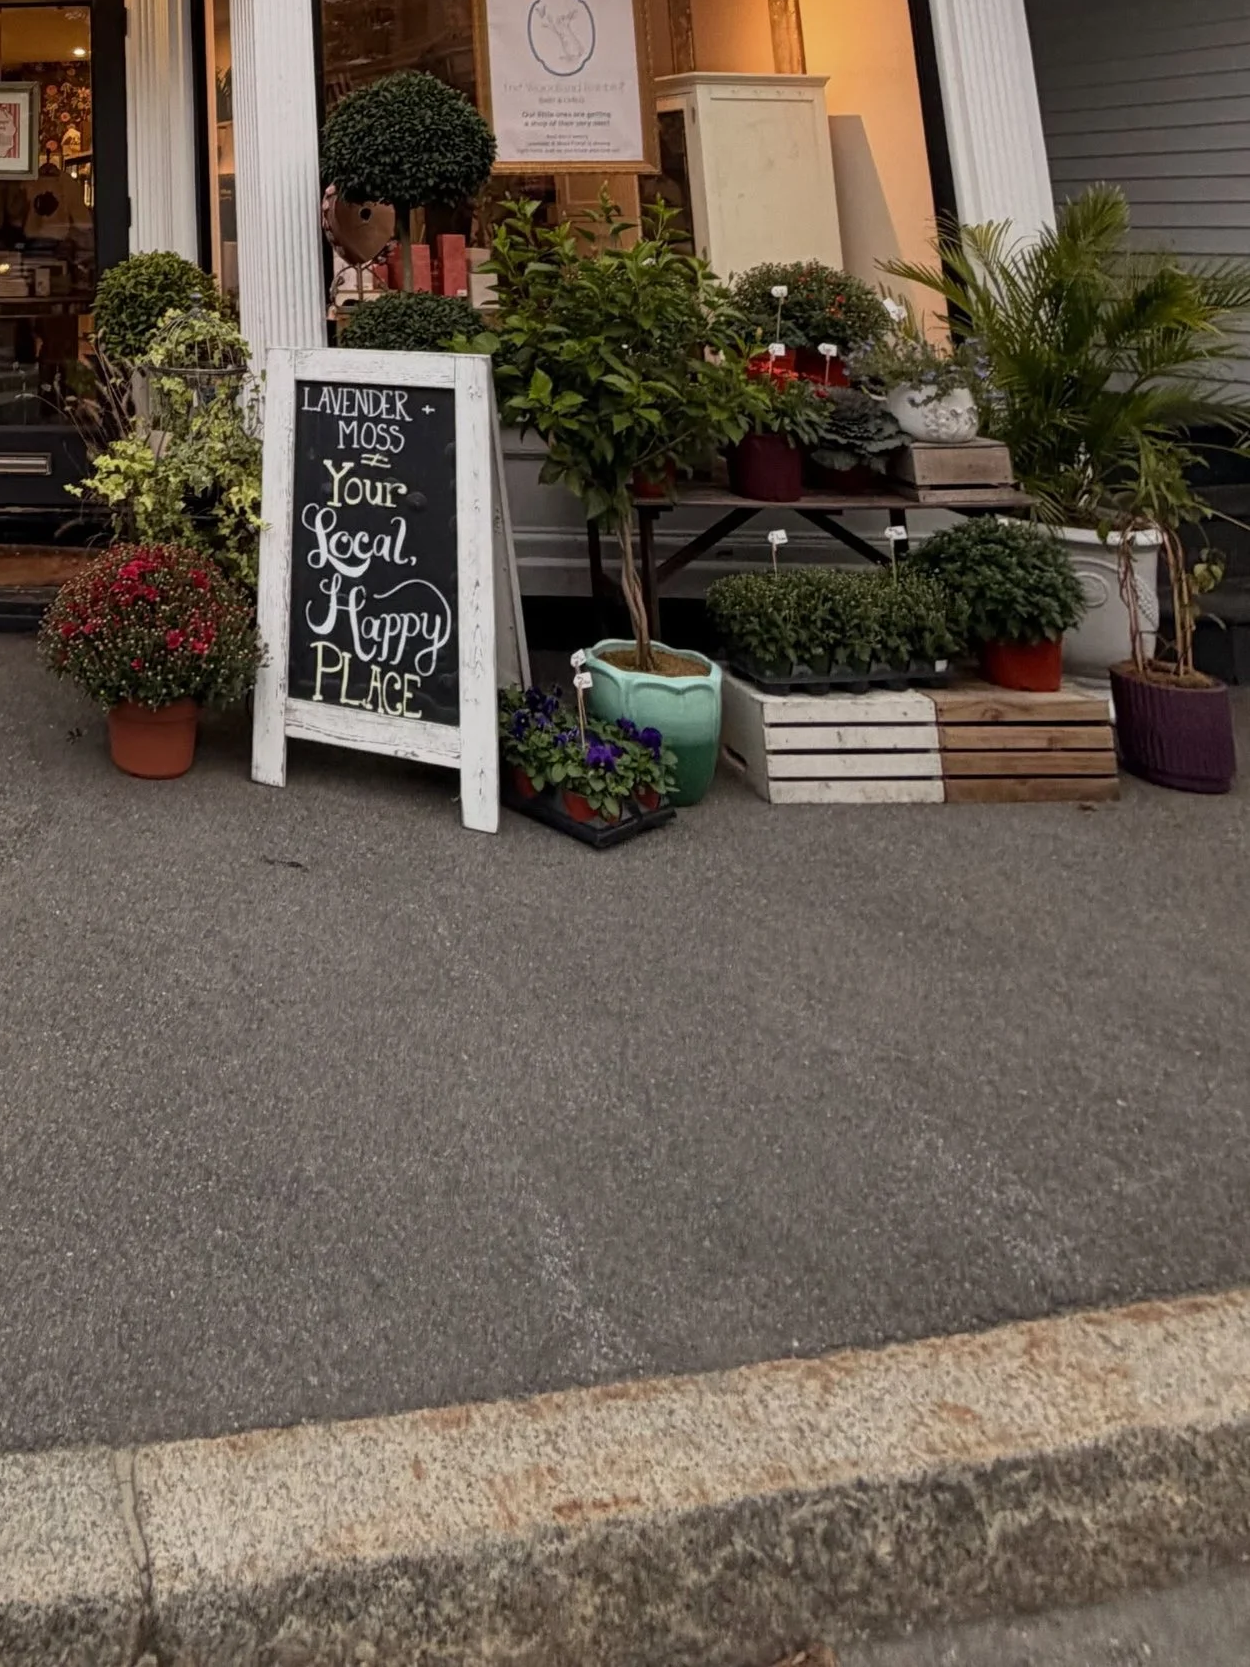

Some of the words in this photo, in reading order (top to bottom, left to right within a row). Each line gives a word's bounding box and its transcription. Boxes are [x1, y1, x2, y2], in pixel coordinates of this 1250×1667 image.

[302, 386, 412, 422] LAVENDER
[337, 420, 405, 454] MOSS
[323, 459, 409, 508] Your
[301, 503, 418, 578] Local,
[305, 572, 452, 677] Happy
[310, 640, 423, 720] PLACE
